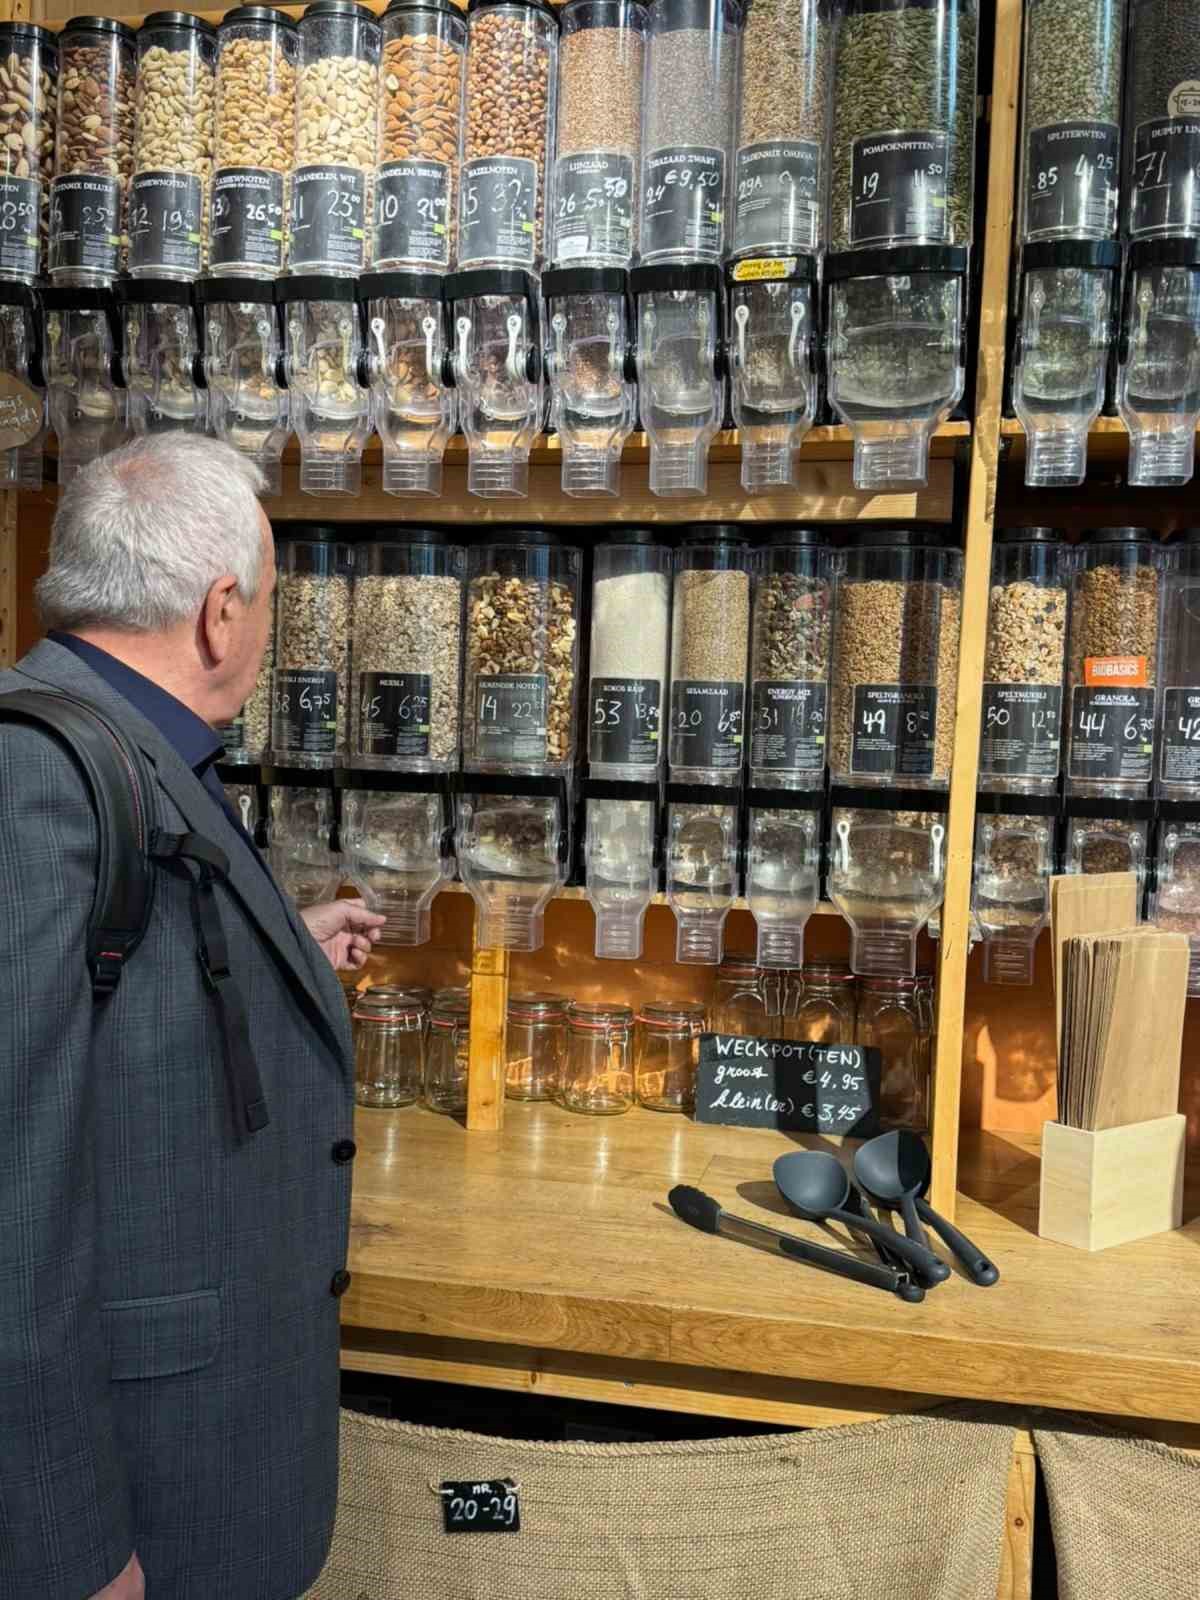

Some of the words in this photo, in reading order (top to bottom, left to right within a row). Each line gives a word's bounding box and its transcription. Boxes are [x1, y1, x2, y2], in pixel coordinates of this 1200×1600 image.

[863, 172, 879, 198] 19
[1037, 167, 1059, 190] 85
[380, 194, 399, 224] 10
[1094, 694, 1137, 702] GRANOLA
[594, 698, 622, 725] 53
[678, 709, 702, 729] 20
[759, 707, 778, 730] 31
[863, 709, 887, 735] 49
[986, 706, 1010, 728] 50
[1080, 711, 1107, 738] 44
